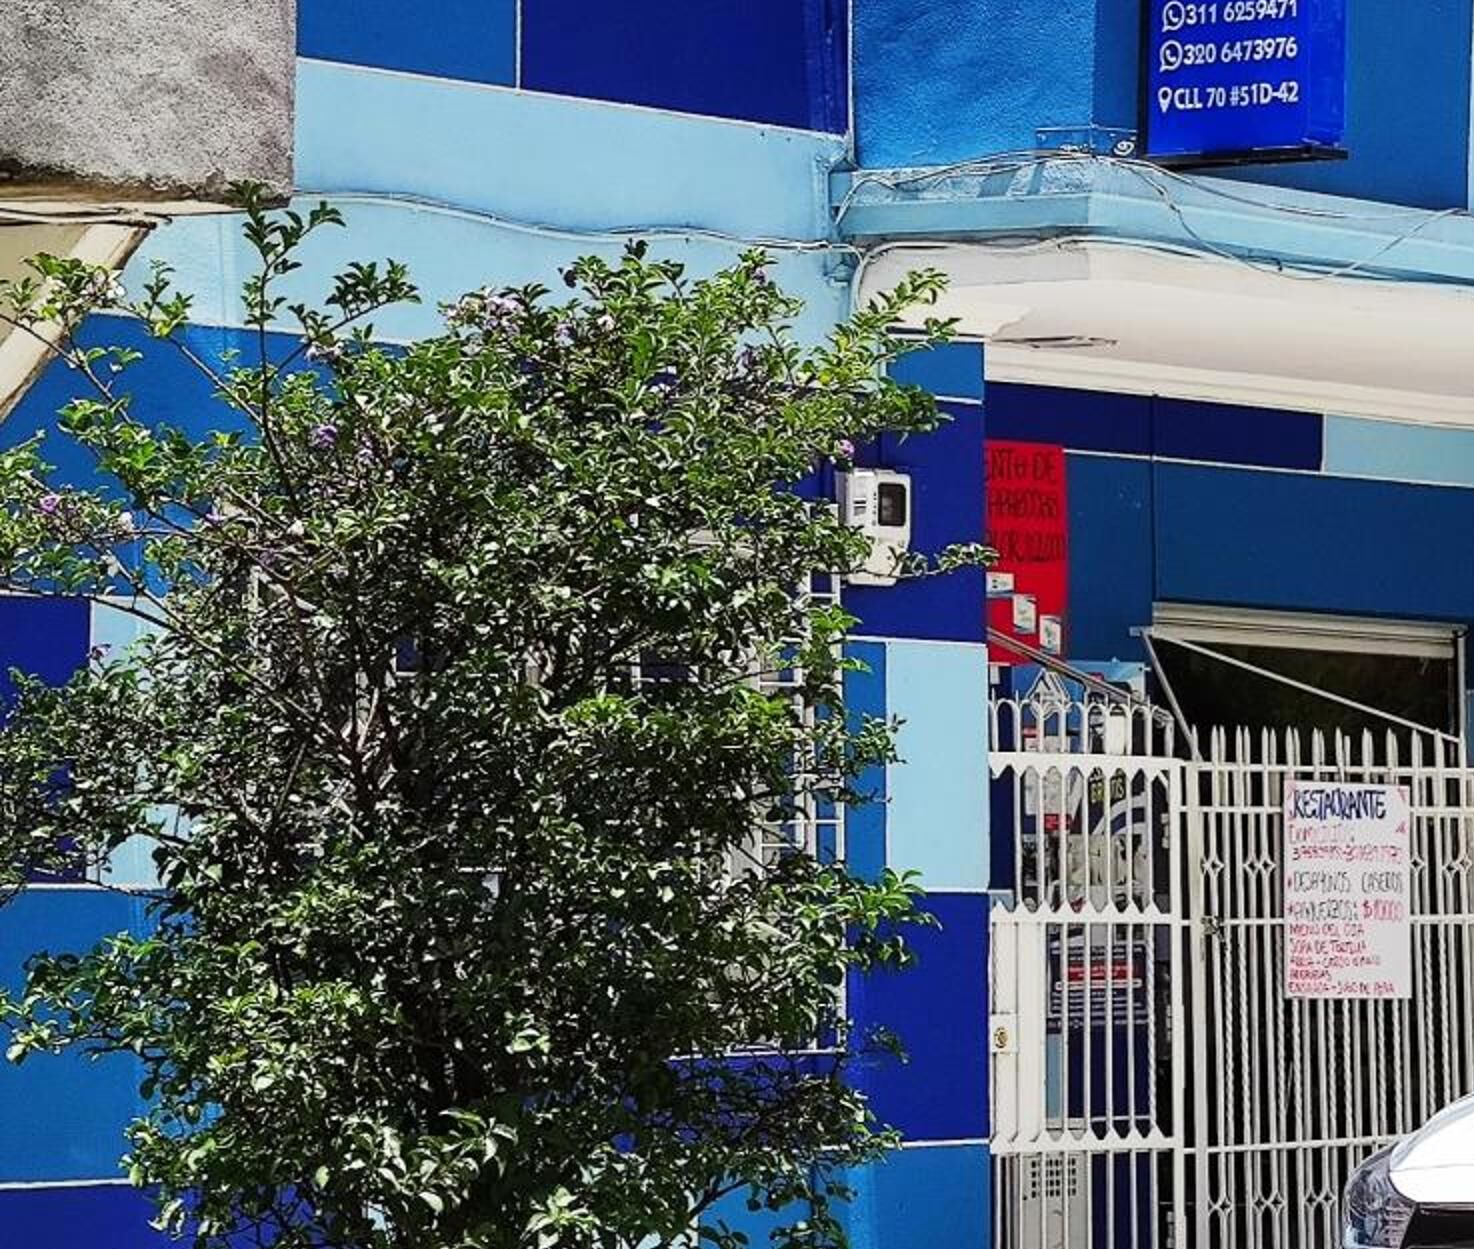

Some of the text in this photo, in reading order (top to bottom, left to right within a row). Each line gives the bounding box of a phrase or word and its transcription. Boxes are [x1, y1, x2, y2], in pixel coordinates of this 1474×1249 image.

[1184, 4, 1217, 25] 311
[1183, 36, 1298, 65] 320 6473976
[1174, 81, 1299, 110] CLL 70 #51D-42
[1291, 788, 1387, 821] RESTAURANTE
